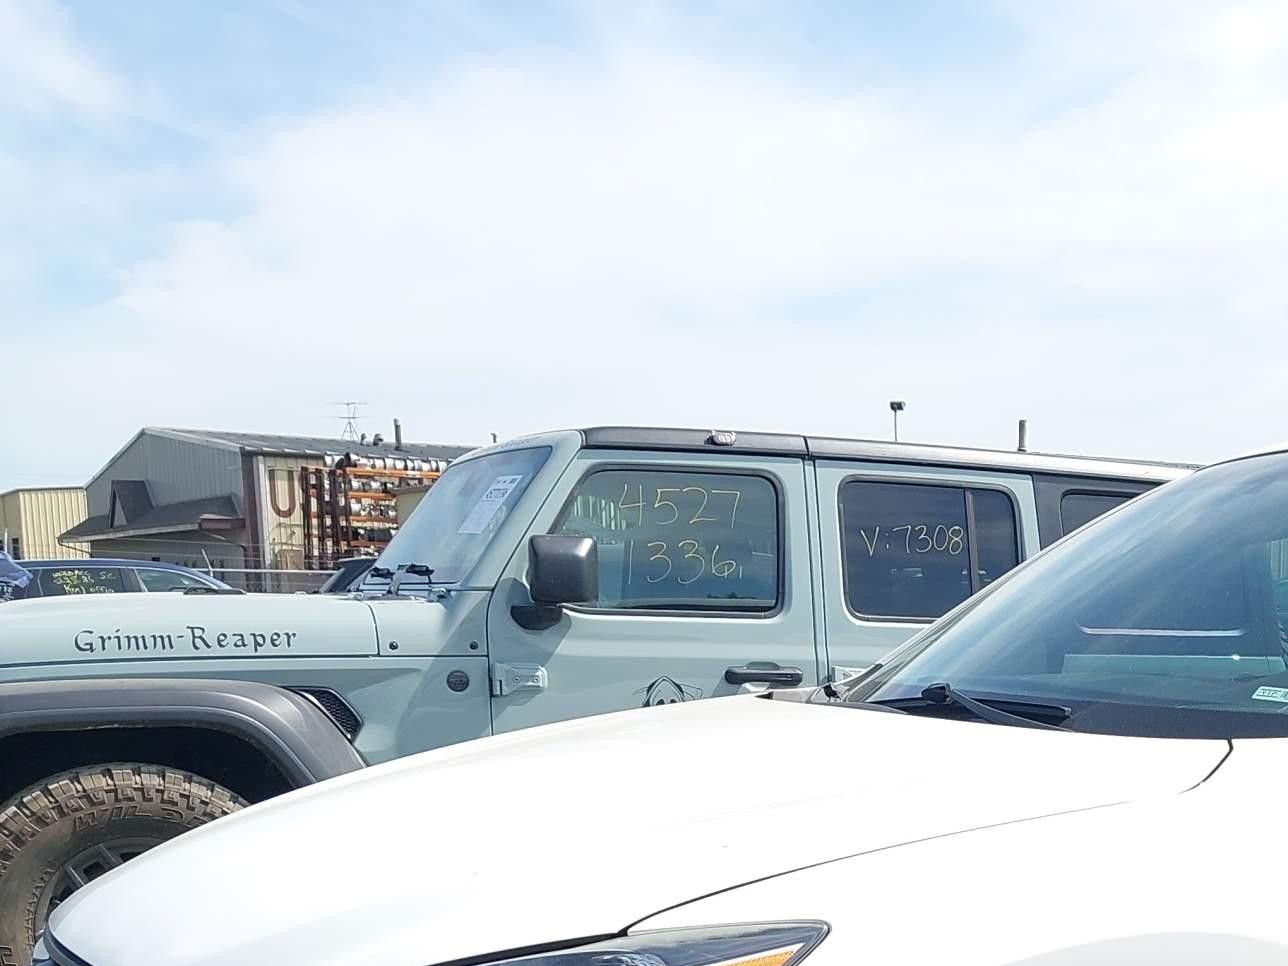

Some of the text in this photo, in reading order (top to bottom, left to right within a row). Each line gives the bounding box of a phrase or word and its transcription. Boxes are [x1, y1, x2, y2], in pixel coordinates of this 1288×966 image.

[618, 483, 741, 528] 4527
[860, 524, 964, 556] V:7308
[74, 625, 297, 653] Grimm-Reaper
